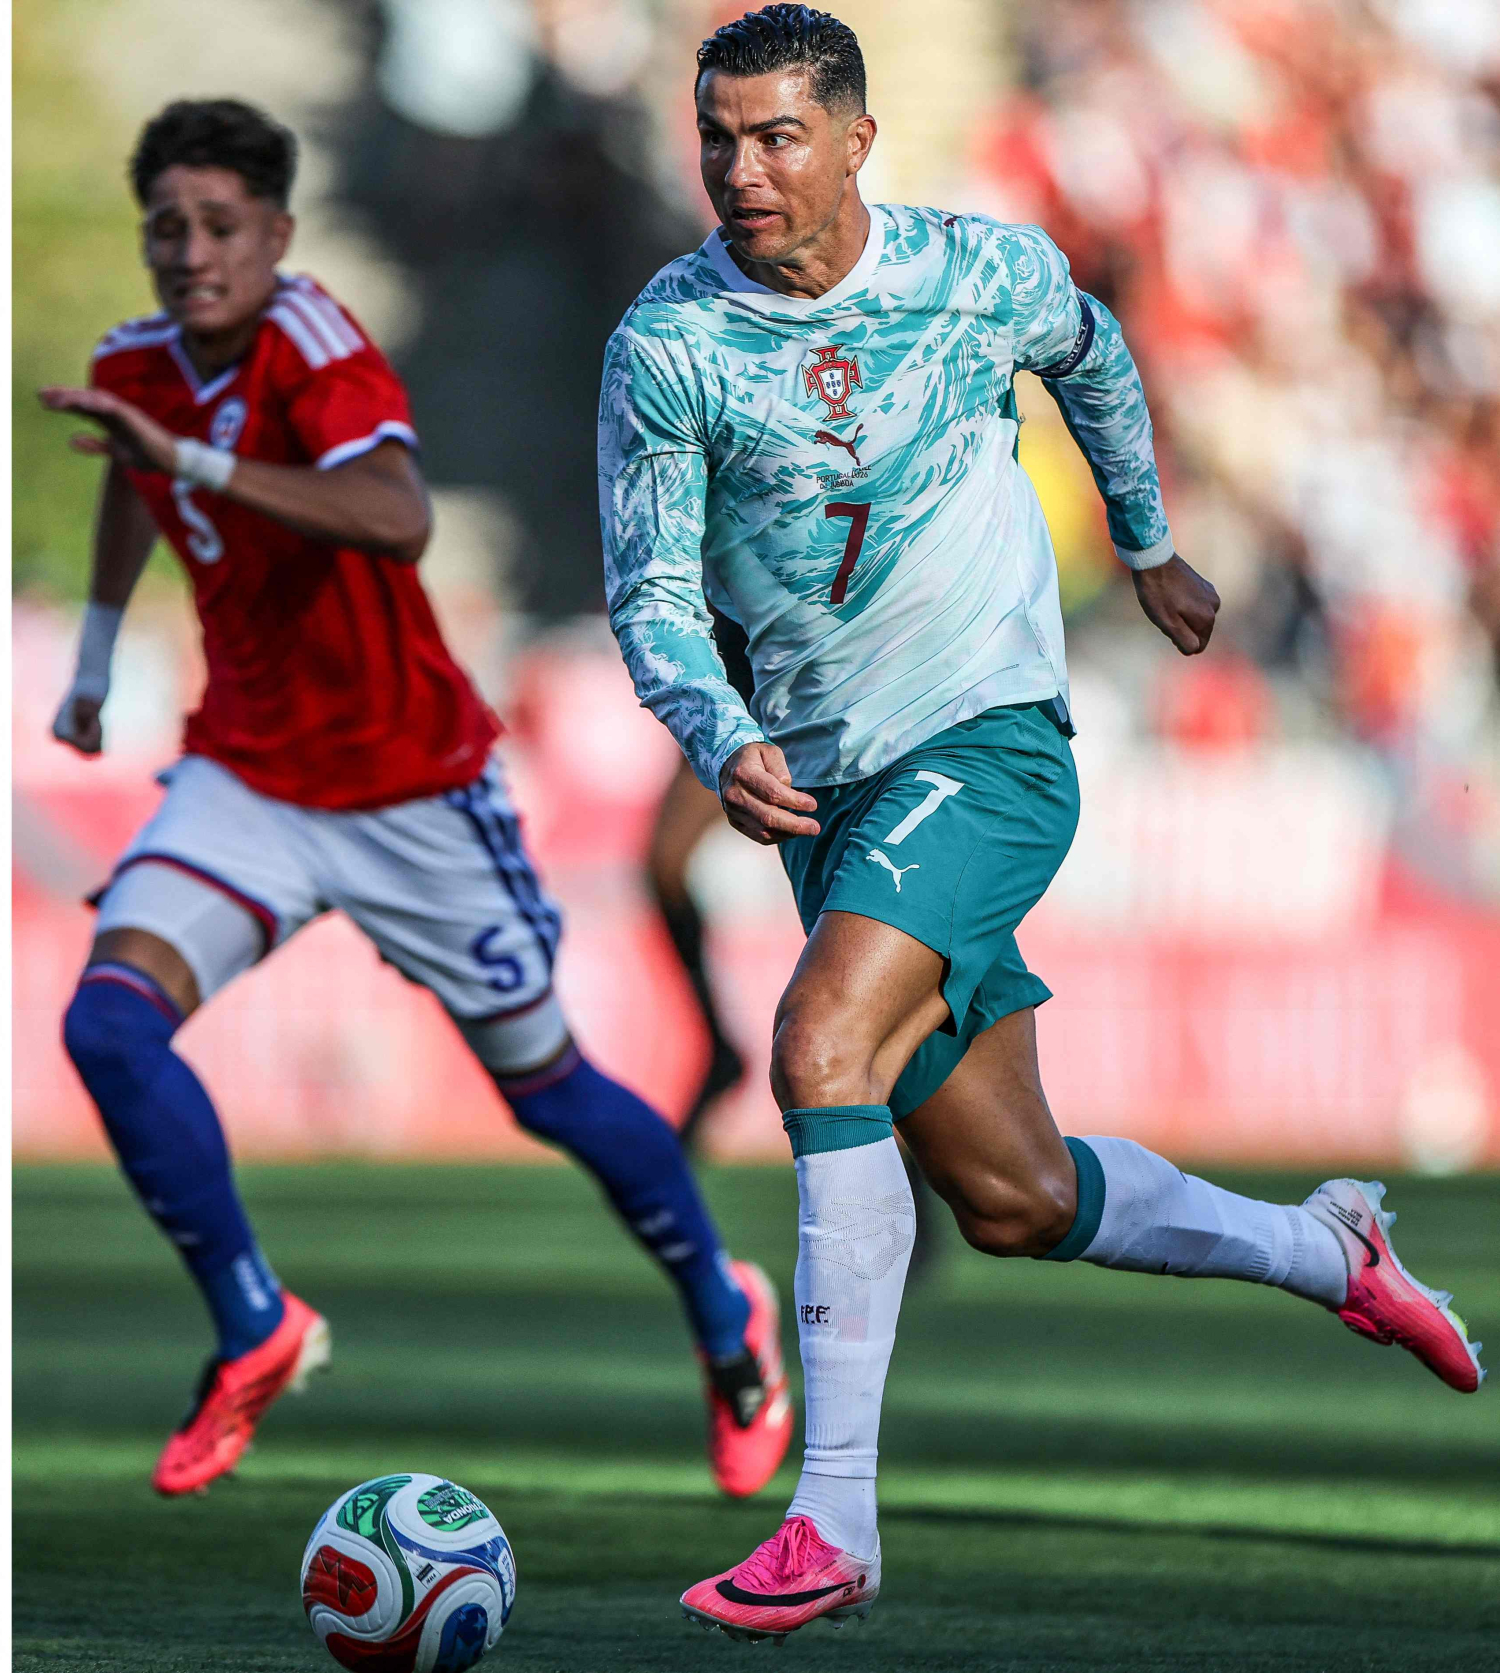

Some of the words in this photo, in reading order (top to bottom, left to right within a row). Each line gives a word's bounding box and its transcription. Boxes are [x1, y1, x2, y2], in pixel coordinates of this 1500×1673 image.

[816, 471, 850, 483] PORTUGAL
[825, 501, 871, 604] 7
[882, 770, 965, 846] 7
[471, 924, 525, 993] 5
[442, 1502, 482, 1525] TRIONDA
